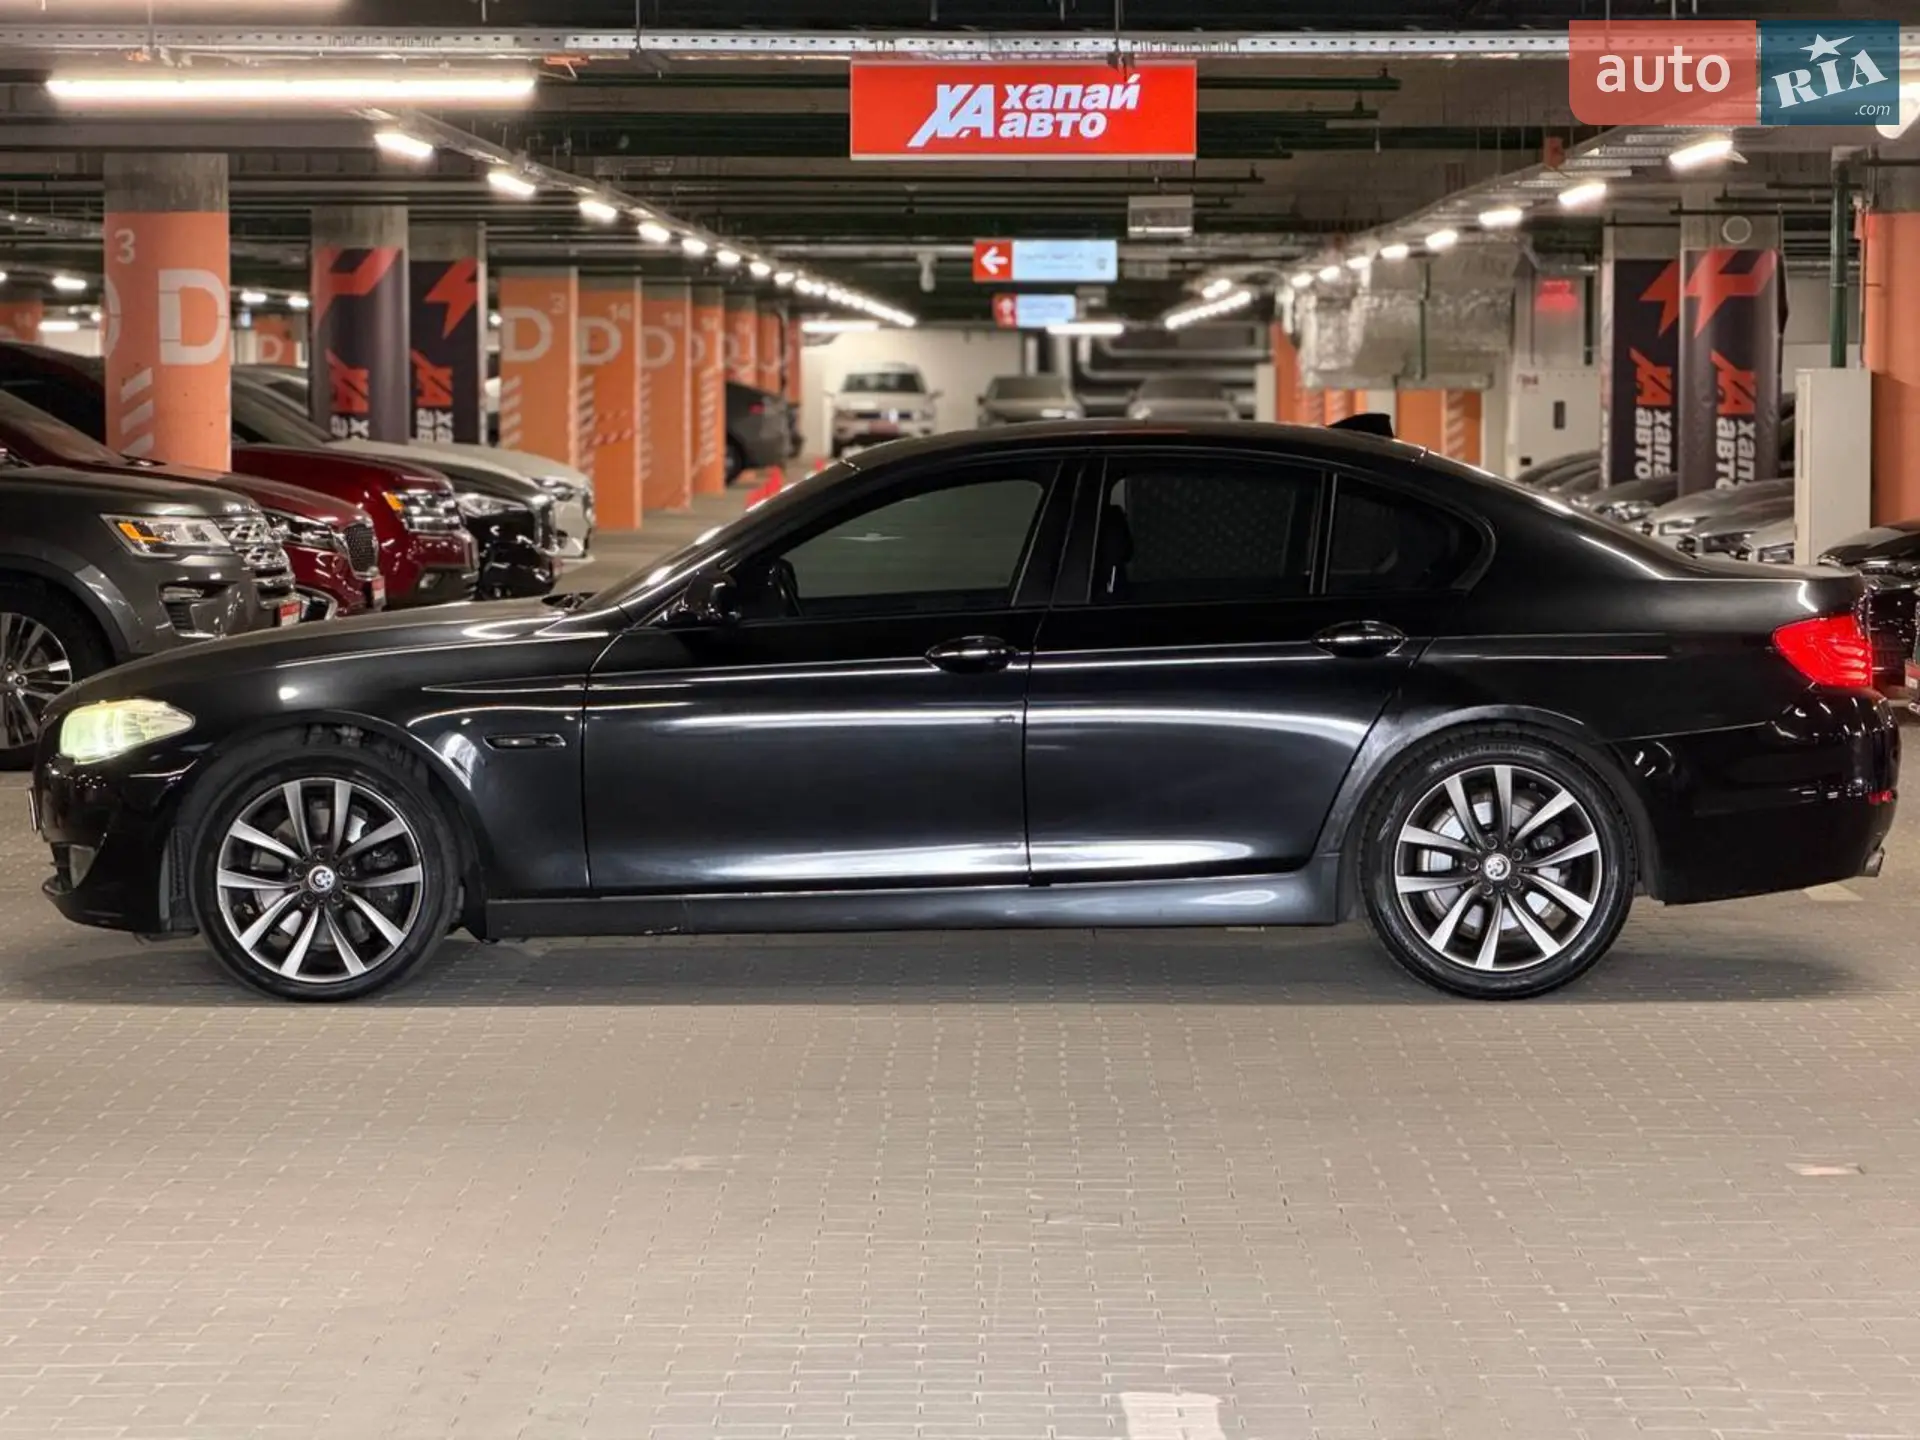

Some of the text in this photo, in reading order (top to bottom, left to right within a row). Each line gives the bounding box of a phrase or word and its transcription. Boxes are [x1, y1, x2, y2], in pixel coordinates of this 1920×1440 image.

[1001, 74, 1141, 110] хапай
[999, 112, 1107, 138] авто
[114, 228, 135, 264] 3
[158, 268, 228, 365] D
